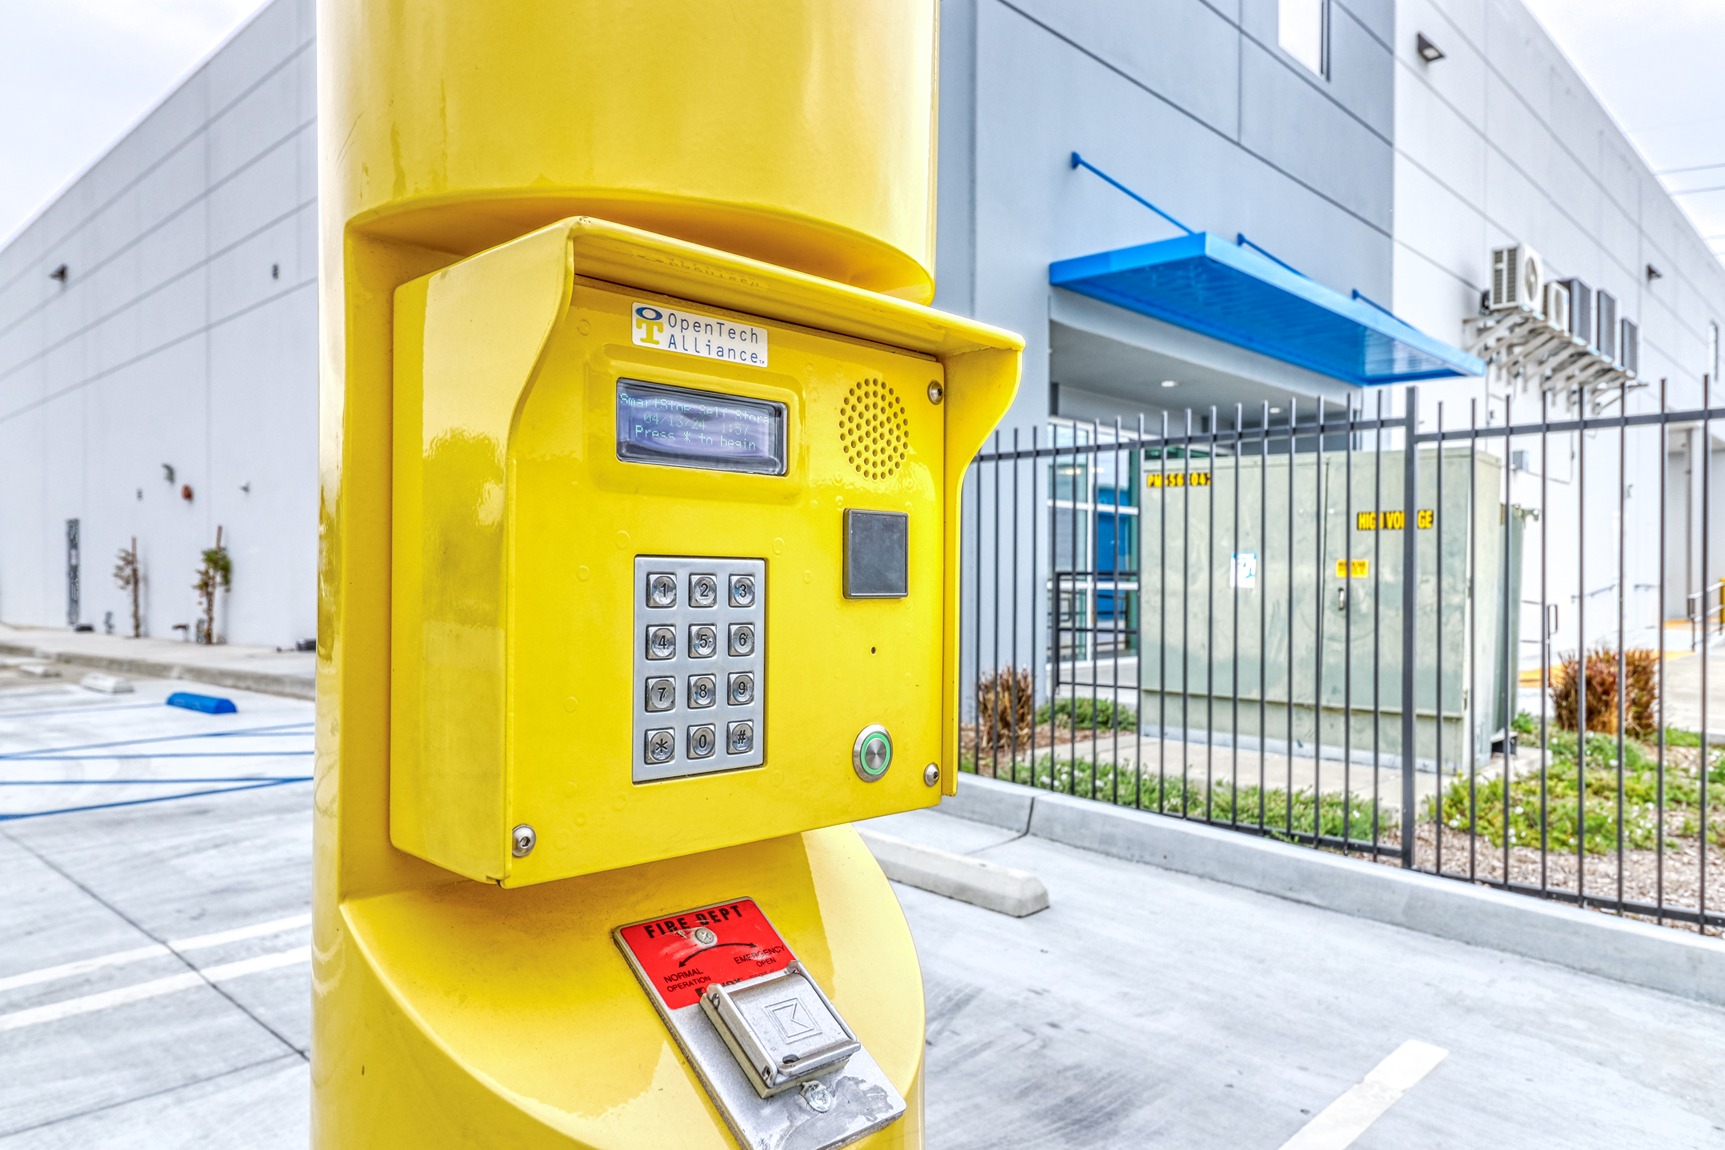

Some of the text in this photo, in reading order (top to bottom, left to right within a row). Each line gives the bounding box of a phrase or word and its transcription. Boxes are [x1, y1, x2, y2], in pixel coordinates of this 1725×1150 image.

[668, 312, 758, 344] OpenTech
[668, 334, 758, 363] Alliance
[635, 424, 676, 441] Press
[660, 583, 668, 598] 1
[700, 583, 708, 597] 2
[739, 584, 747, 598] 3
[657, 635, 667, 649] 4
[699, 634, 708, 648] 5
[738, 632, 747, 646] 6
[657, 687, 667, 701] 7
[699, 684, 707, 698] 8
[738, 681, 746, 695] 9
[698, 734, 706, 749] 0
[737, 730, 746, 744] #
[643, 905, 743, 938] FIRE DEPT
[733, 945, 785, 964] EMERGENCY
[756, 957, 776, 968] OPEN
[663, 968, 704, 983] NORMAL
[666, 975, 712, 993] OPERATION
